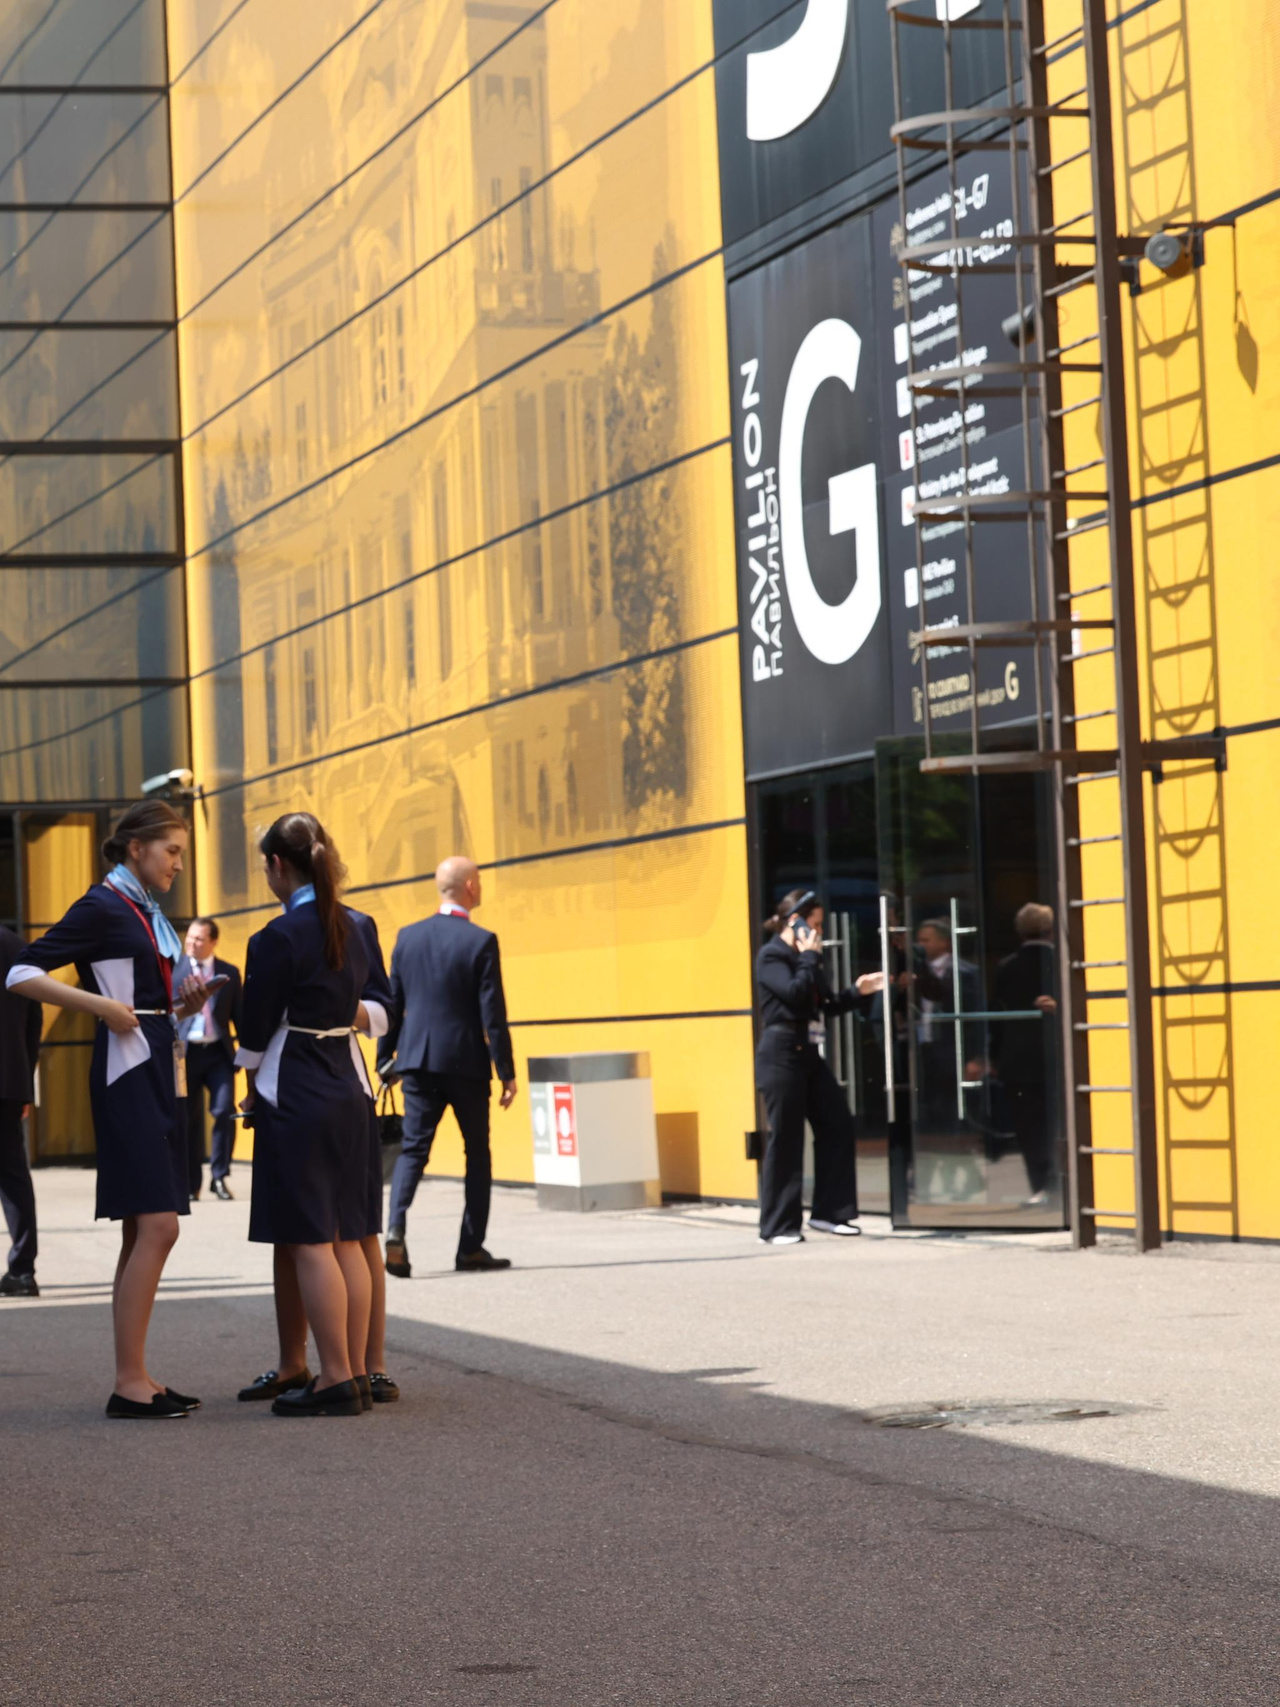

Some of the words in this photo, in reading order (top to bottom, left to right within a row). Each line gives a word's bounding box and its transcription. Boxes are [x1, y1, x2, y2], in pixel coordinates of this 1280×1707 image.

[740, 358, 771, 682] PAVILION
[764, 466, 783, 677] ПАВИЛЬОН
[779, 318, 881, 664] G
[1005, 661, 1019, 701] G
